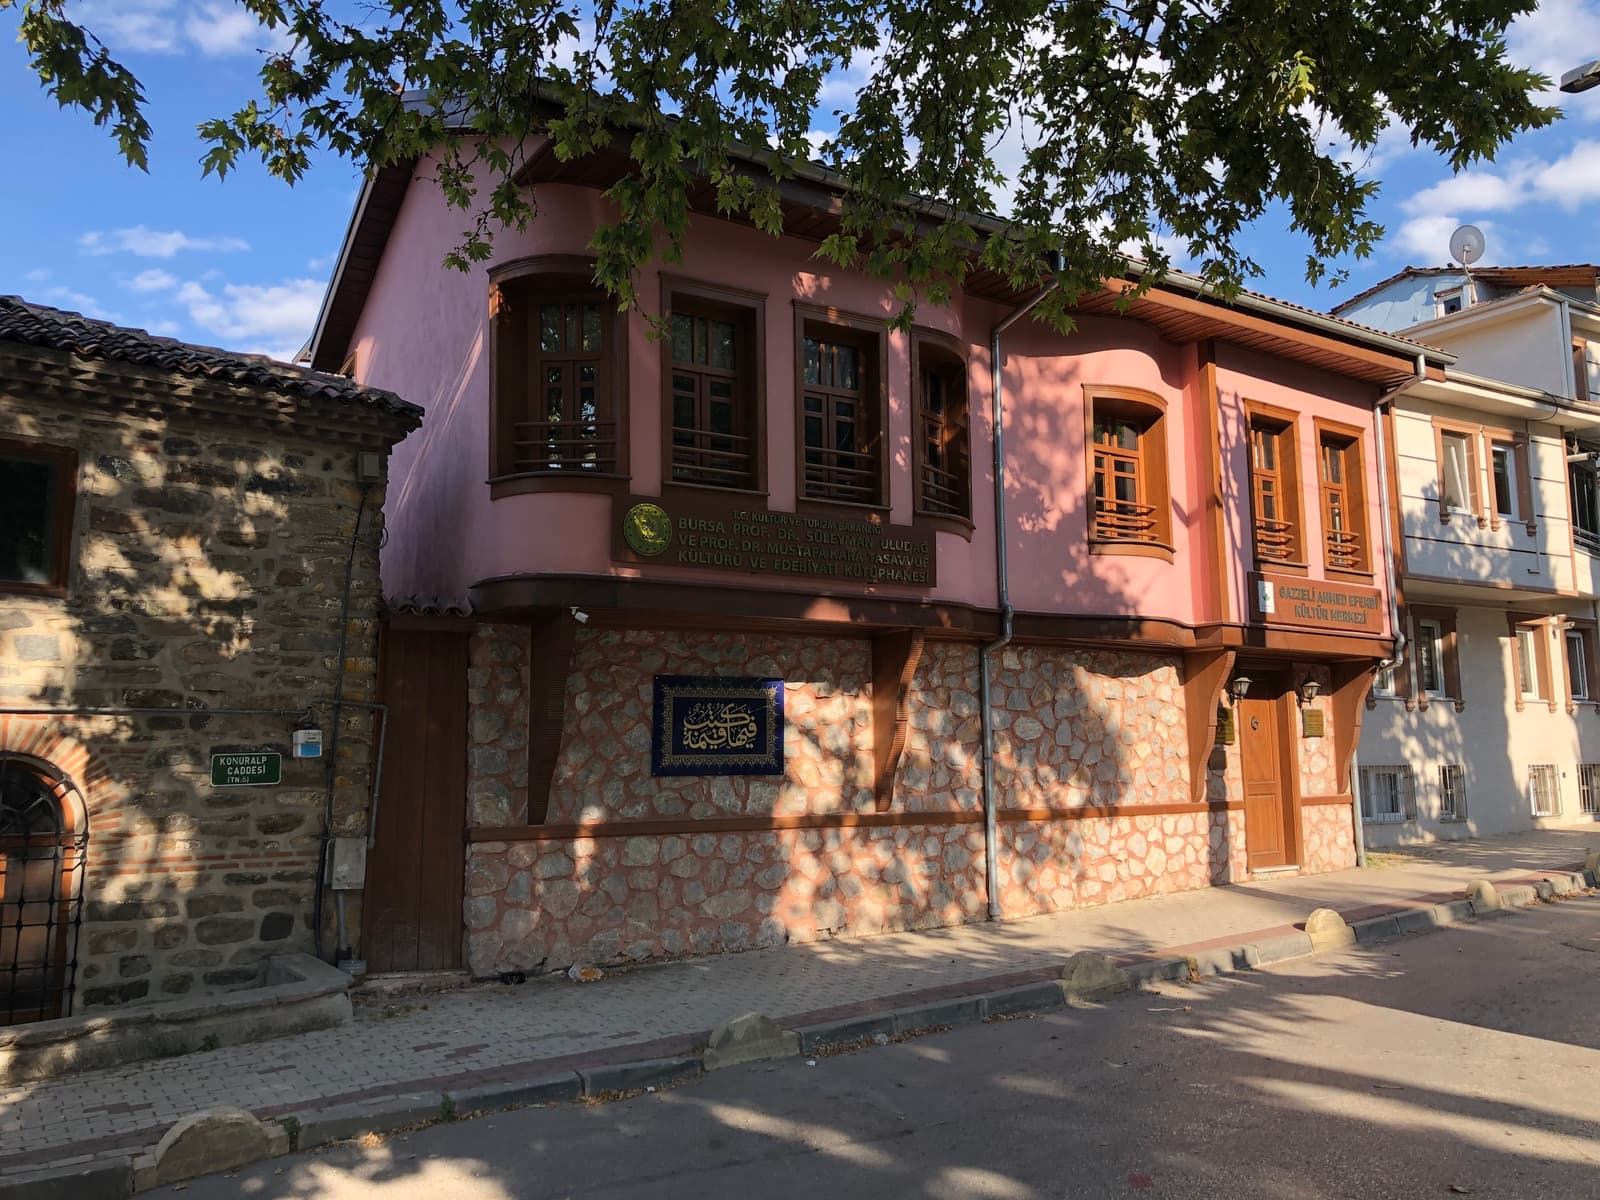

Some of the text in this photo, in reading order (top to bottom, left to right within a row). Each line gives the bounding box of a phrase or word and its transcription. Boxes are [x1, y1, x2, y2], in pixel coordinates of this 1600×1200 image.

[788, 515, 801, 527] VE
[679, 517, 726, 533] BURSA
[734, 523, 770, 537] PROF.
[778, 528, 799, 542] DR.
[807, 529, 873, 548] SÜLEYMAN
[679, 534, 696, 546] VE
[768, 543, 827, 559] MUSTAFA
[830, 549, 864, 562] KARA
[679, 547, 742, 567] KÜLTÜRÜ
[750, 556, 766, 569] VE
[1279, 585, 1379, 610] GAZZELİ AHMED EFENDİ
[1294, 603, 1329, 621] KÜLTÜR
[1330, 609, 1367, 625] MERKEZİ
[219, 755, 268, 766] KONURALP
[227, 765, 266, 775] CADDESİ
